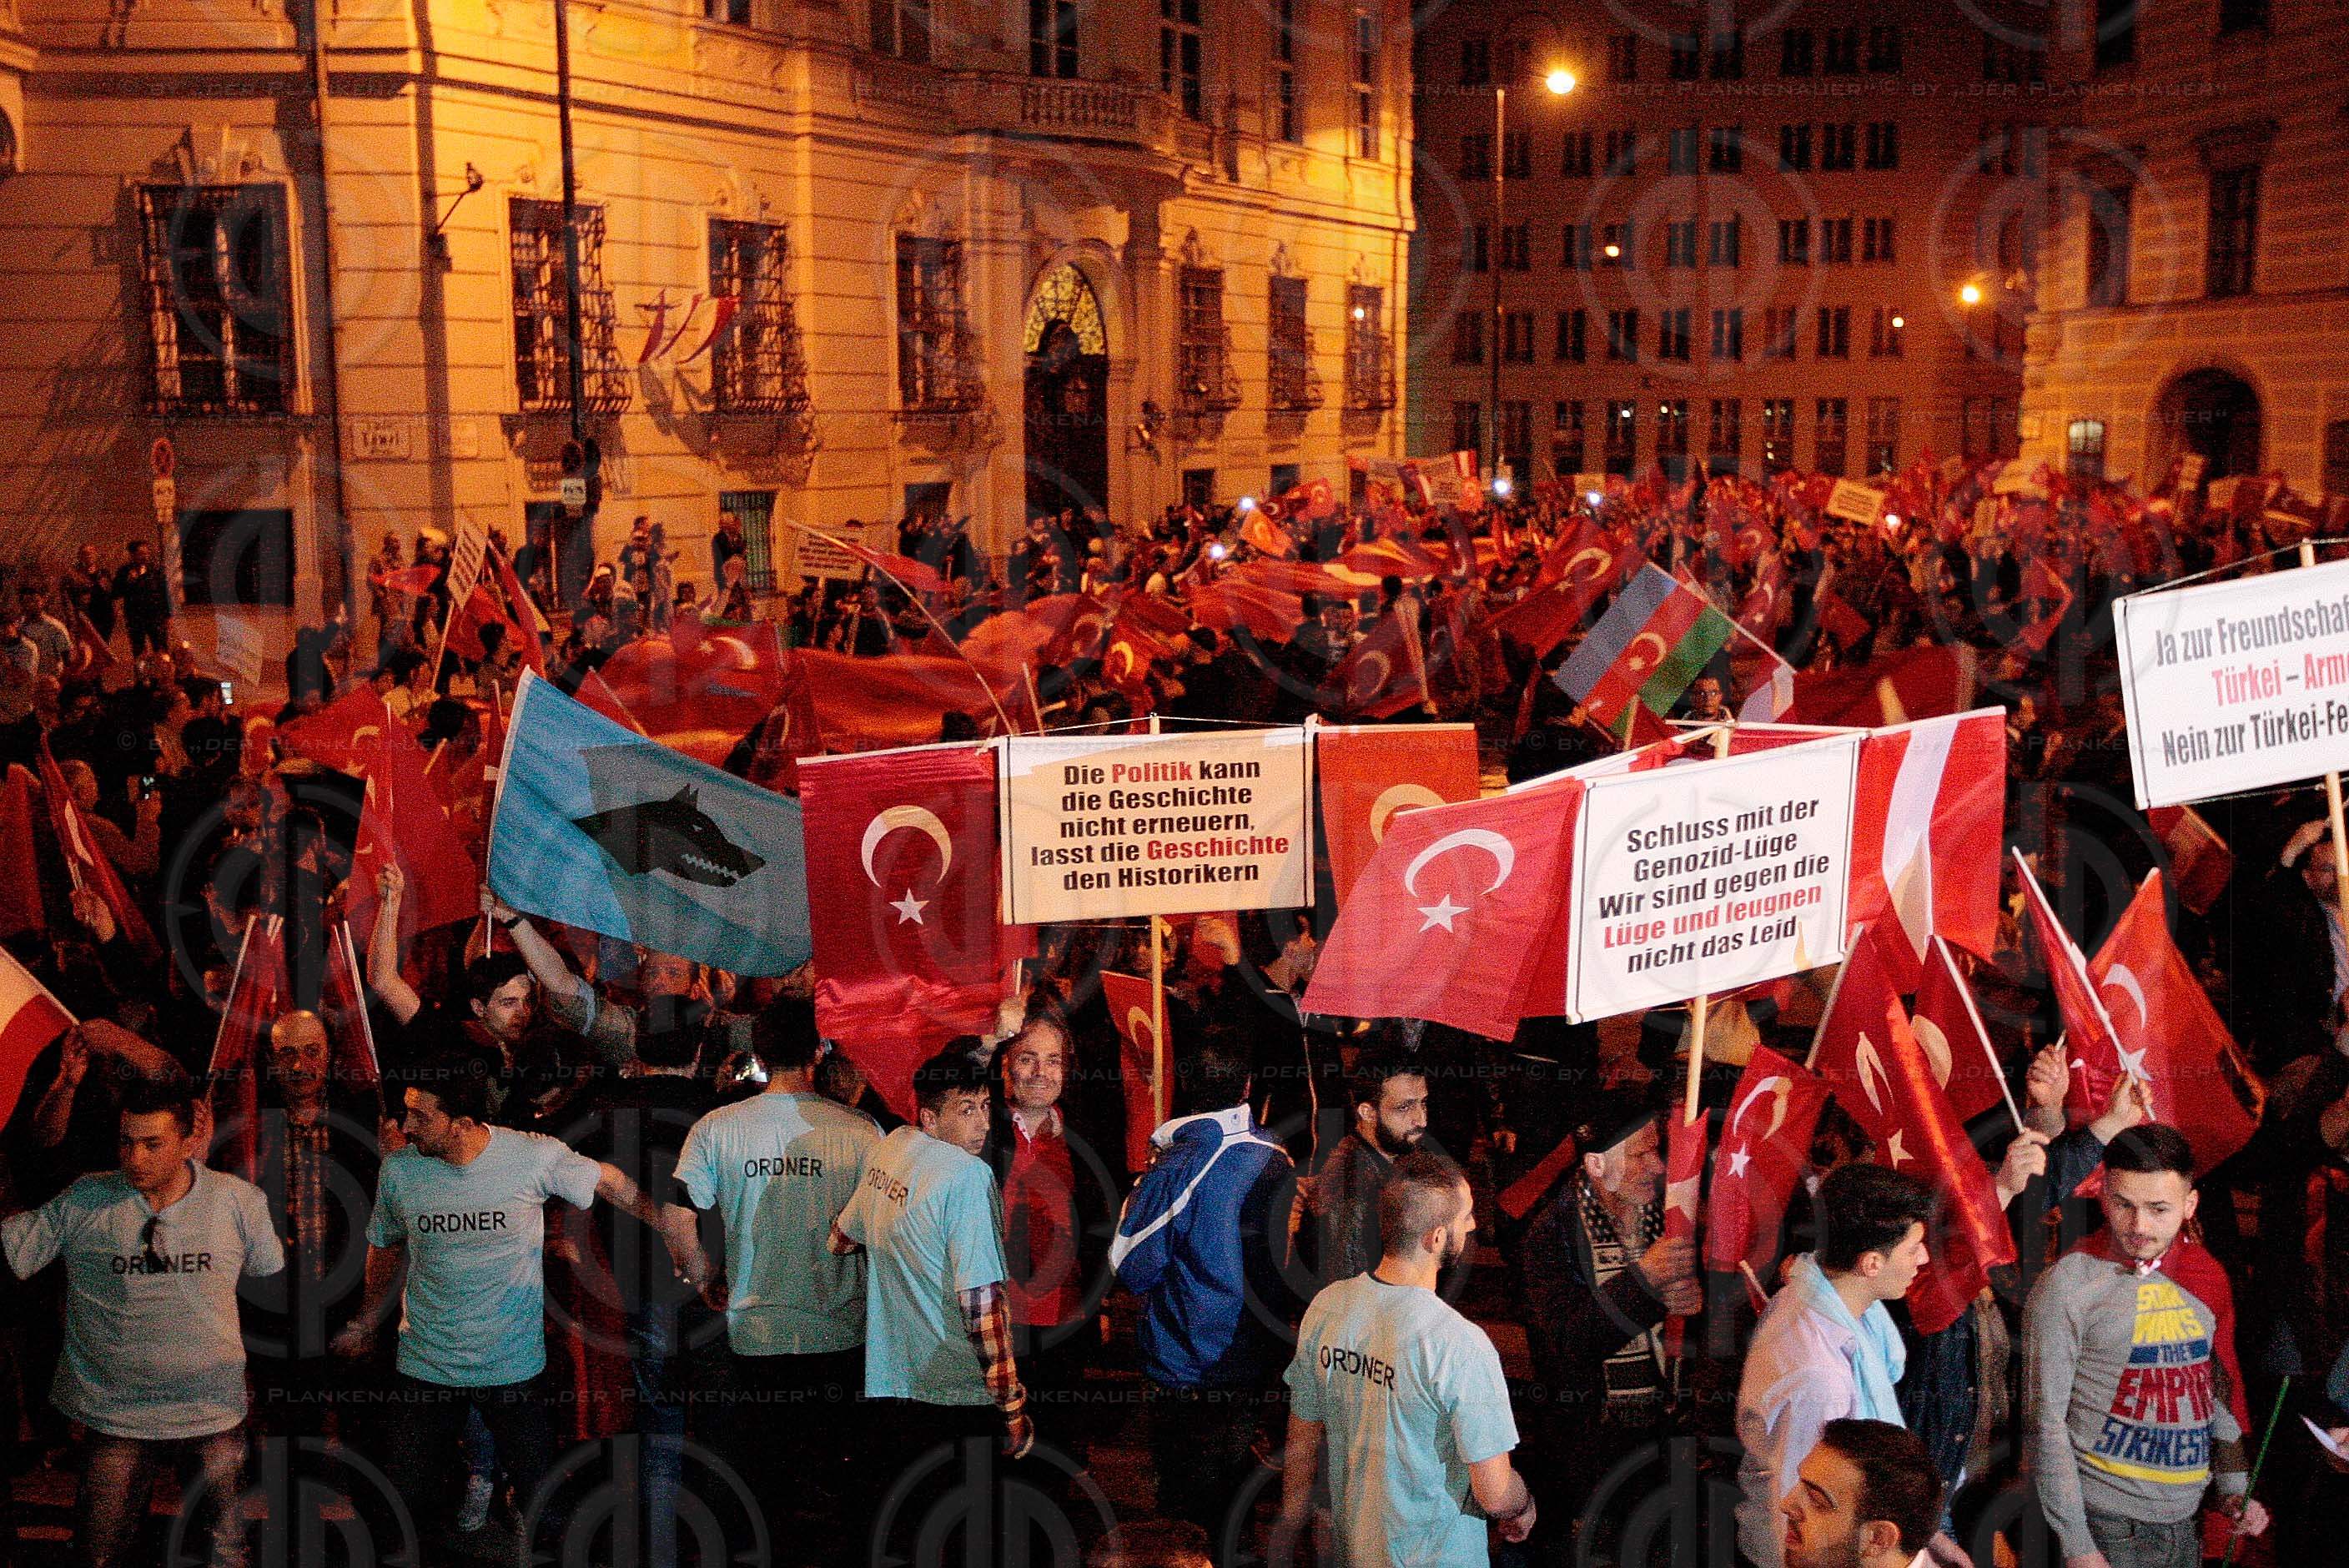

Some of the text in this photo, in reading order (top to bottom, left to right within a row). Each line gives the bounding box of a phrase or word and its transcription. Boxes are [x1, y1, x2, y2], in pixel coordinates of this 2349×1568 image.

[2155, 630, 2178, 667] Ja
[2181, 626, 2212, 662] zur
[2211, 660, 2282, 706] Türkei
[2161, 726, 2211, 768] Nein
[2214, 722, 2246, 757] zur
[1064, 760, 1260, 786] Die Politik kann
[1062, 787, 1252, 812] die Geschichte
[1061, 812, 1255, 838] nicht erneuern,
[1627, 798, 1820, 853] Schluss mit der
[1031, 835, 1289, 867] lasst die Geschichte
[1633, 832, 1798, 882] Genozid-Lüge
[1064, 862, 1259, 891] den Historikern
[1599, 854, 1829, 919] Wir sind gegen die
[1604, 885, 1822, 949] Lüge und leugnen
[1627, 916, 1797, 973] nicht das Leid
[745, 1157, 823, 1179] ORDNER
[868, 1167, 909, 1208] ORDNER
[418, 1211, 507, 1234] ORDNER
[112, 1252, 213, 1274] ORNER
[1320, 1344, 1395, 1390] ORDNER
[2110, 1361, 2216, 1424] EMPIR
